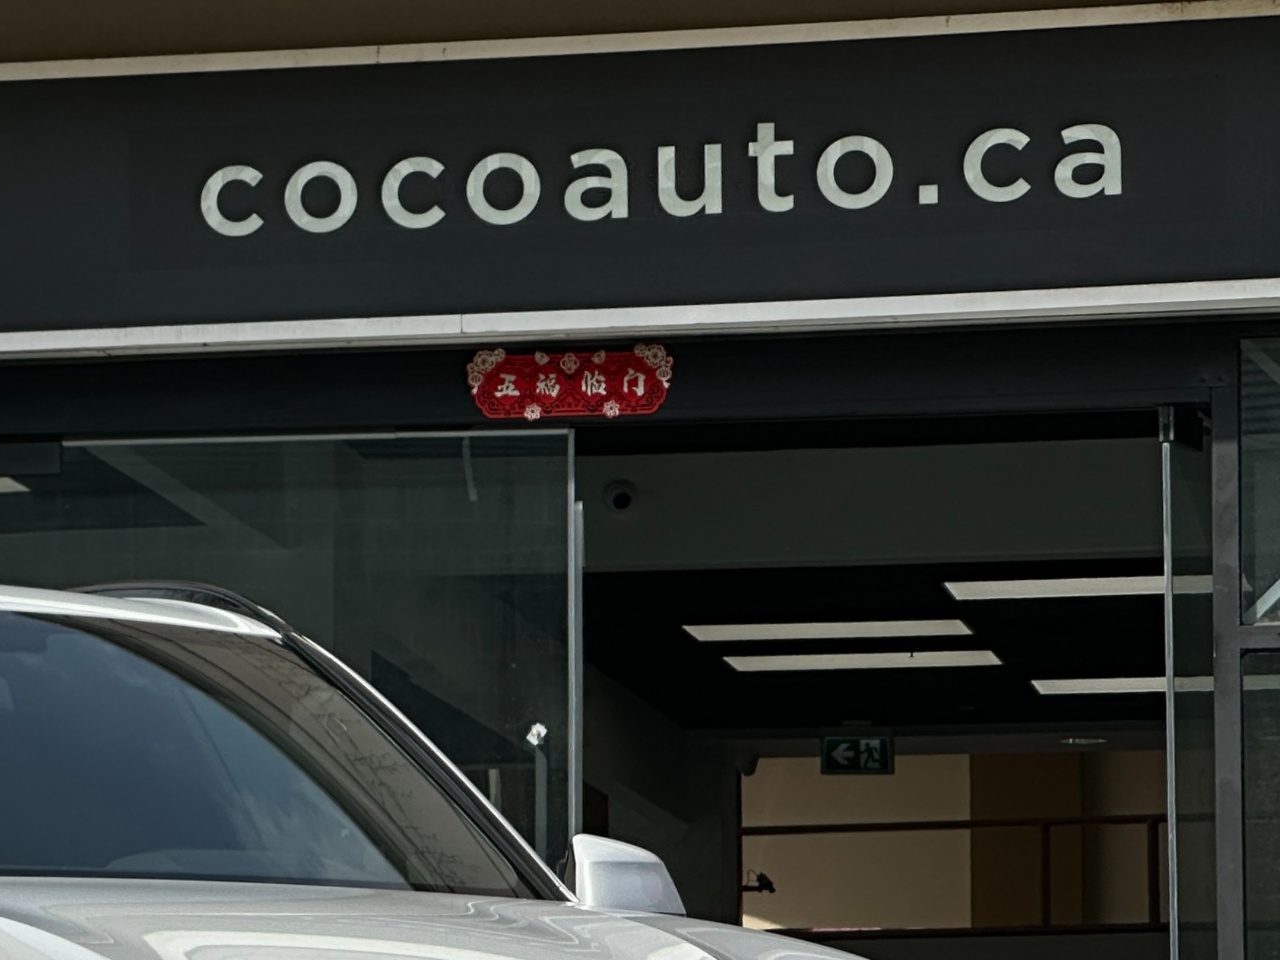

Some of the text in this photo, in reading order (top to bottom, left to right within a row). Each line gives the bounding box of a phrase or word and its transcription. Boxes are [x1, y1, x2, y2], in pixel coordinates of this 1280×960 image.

[200, 121, 1123, 237] cocoauto.ca
[494, 368, 646, 398] 五福临门
